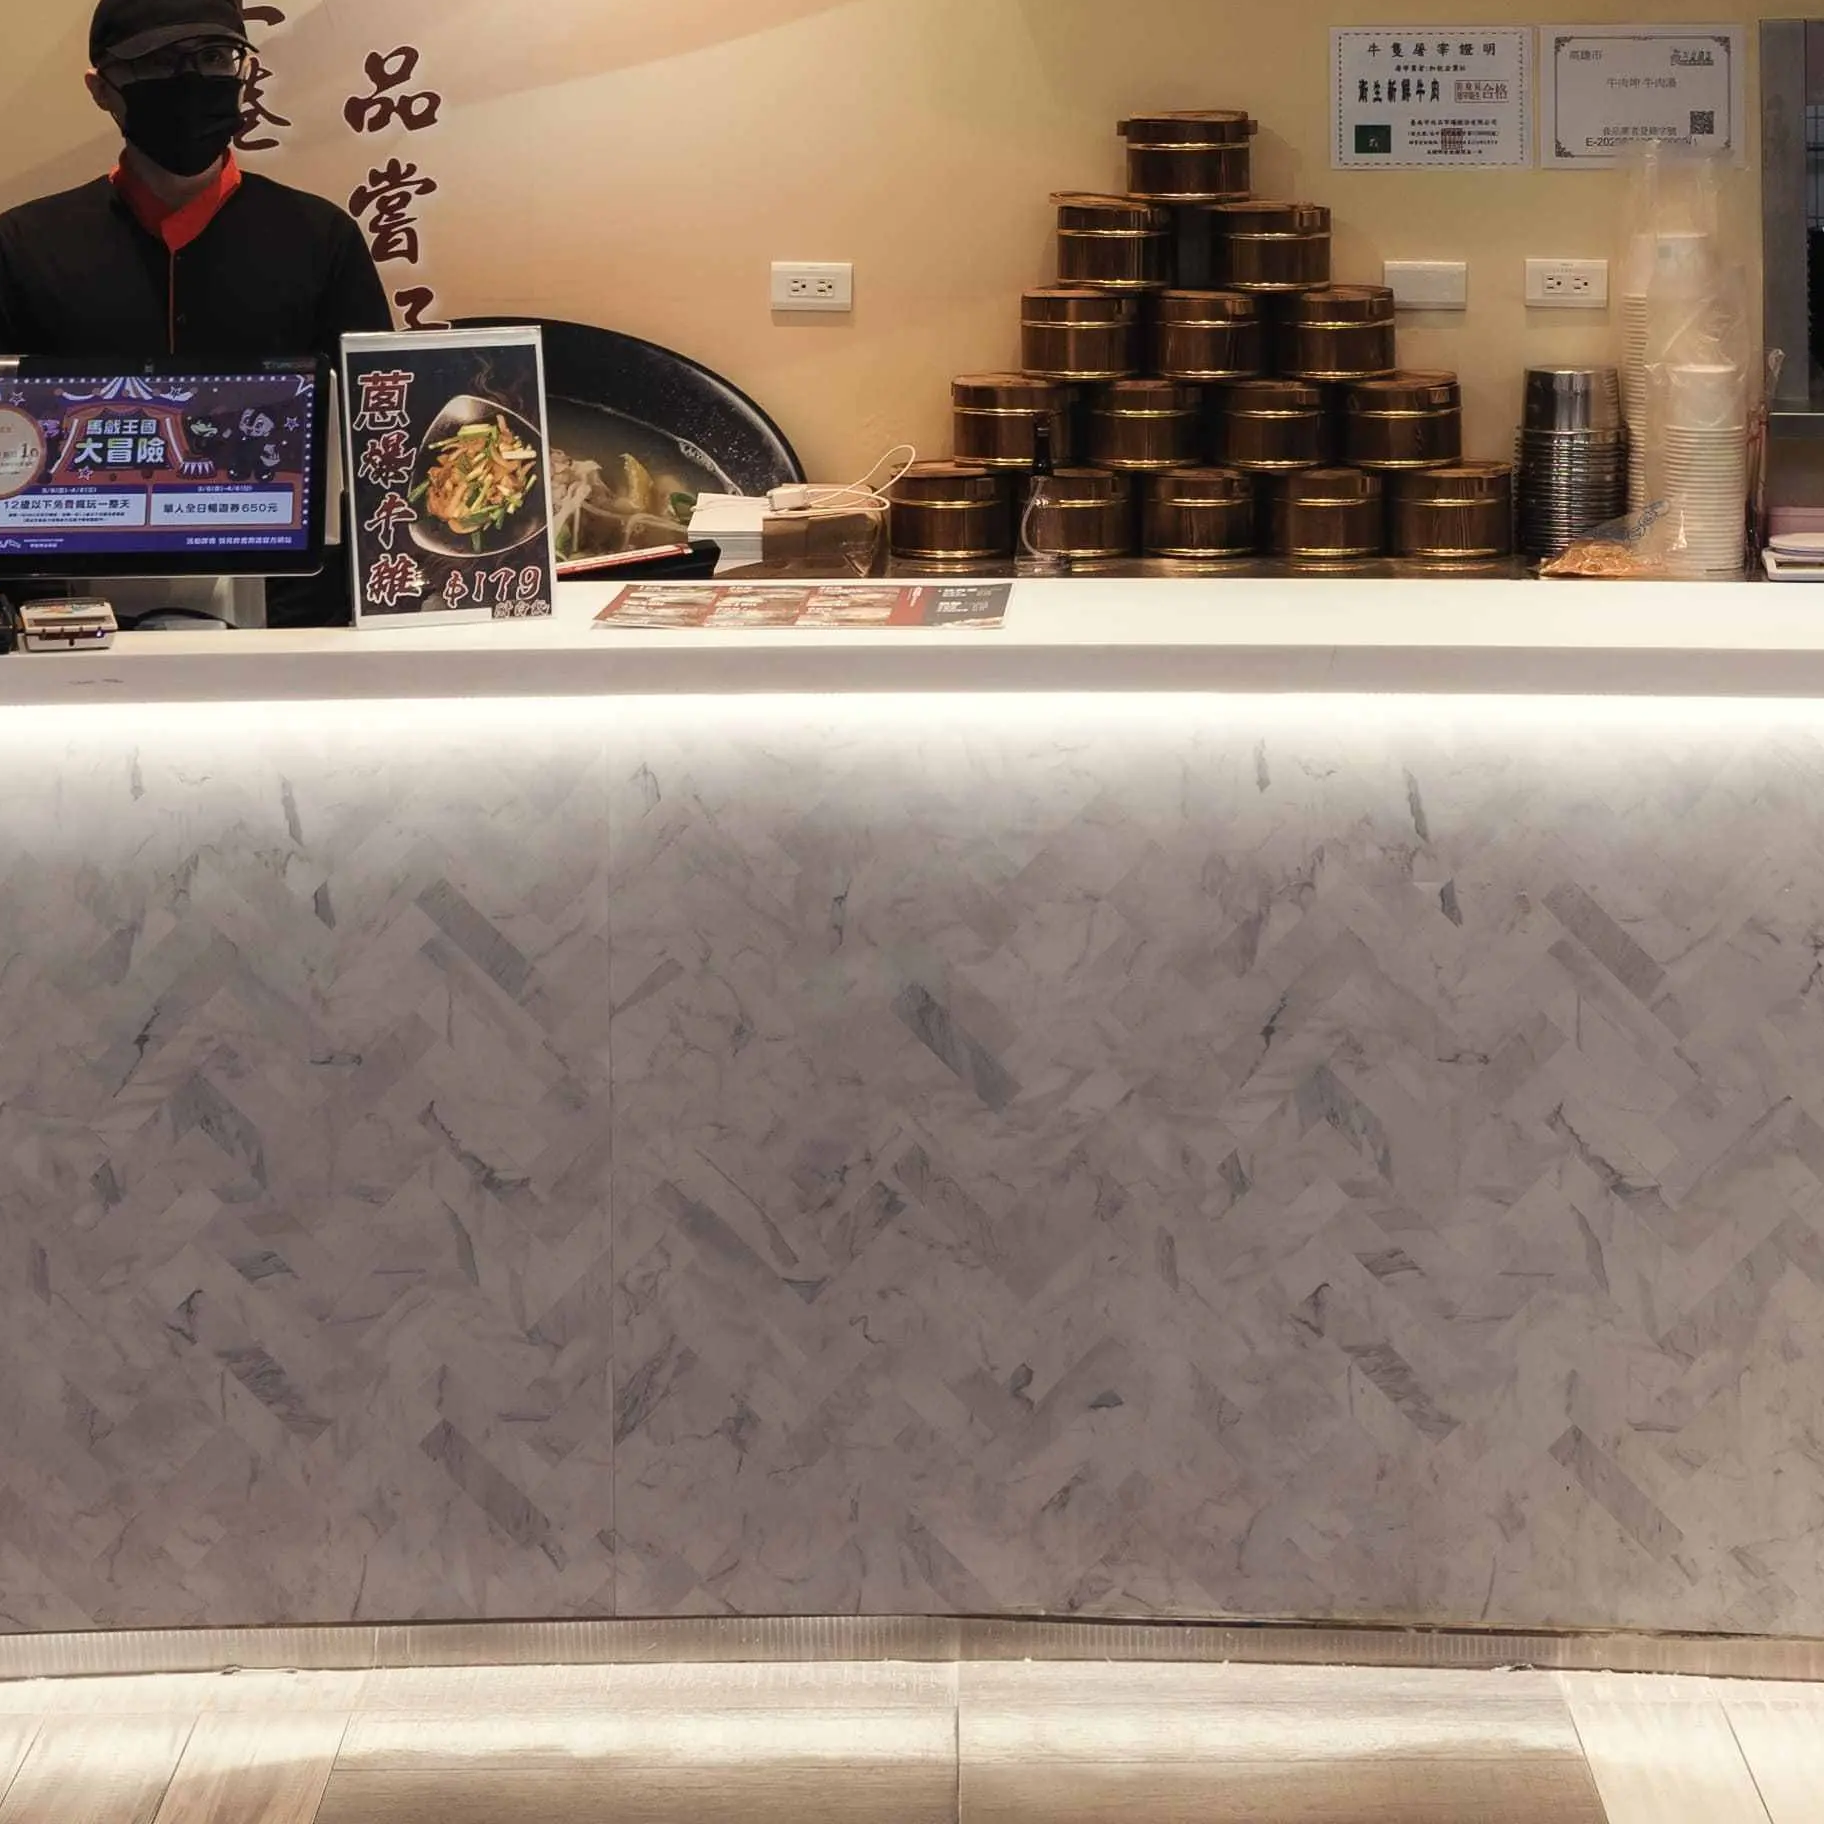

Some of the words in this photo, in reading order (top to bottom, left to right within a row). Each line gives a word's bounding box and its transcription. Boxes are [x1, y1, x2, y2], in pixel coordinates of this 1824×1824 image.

[85, 417, 158, 436] 馬戲王國
[73, 435, 167, 465] 大冒險
[442, 565, 542, 609] $179
